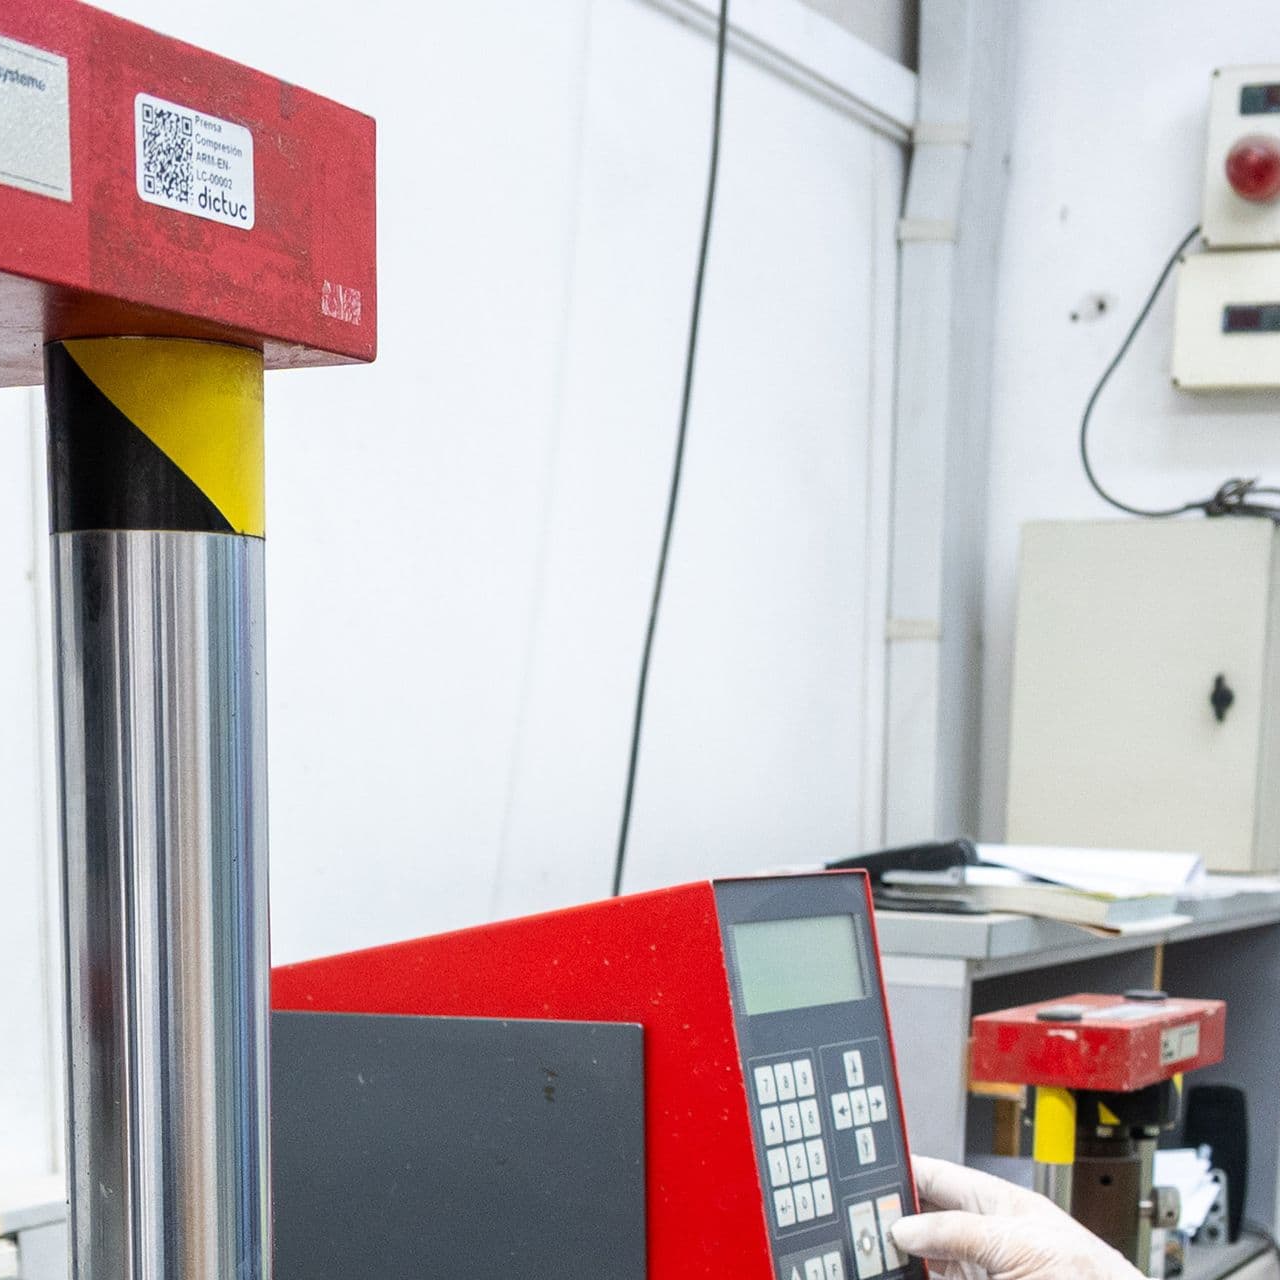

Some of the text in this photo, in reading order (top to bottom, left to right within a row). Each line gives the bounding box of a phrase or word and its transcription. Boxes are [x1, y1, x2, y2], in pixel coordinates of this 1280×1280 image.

[195, 114, 222, 133] Prensa
[195, 133, 243, 158] Compresión
[198, 185, 248, 220] dictuc
